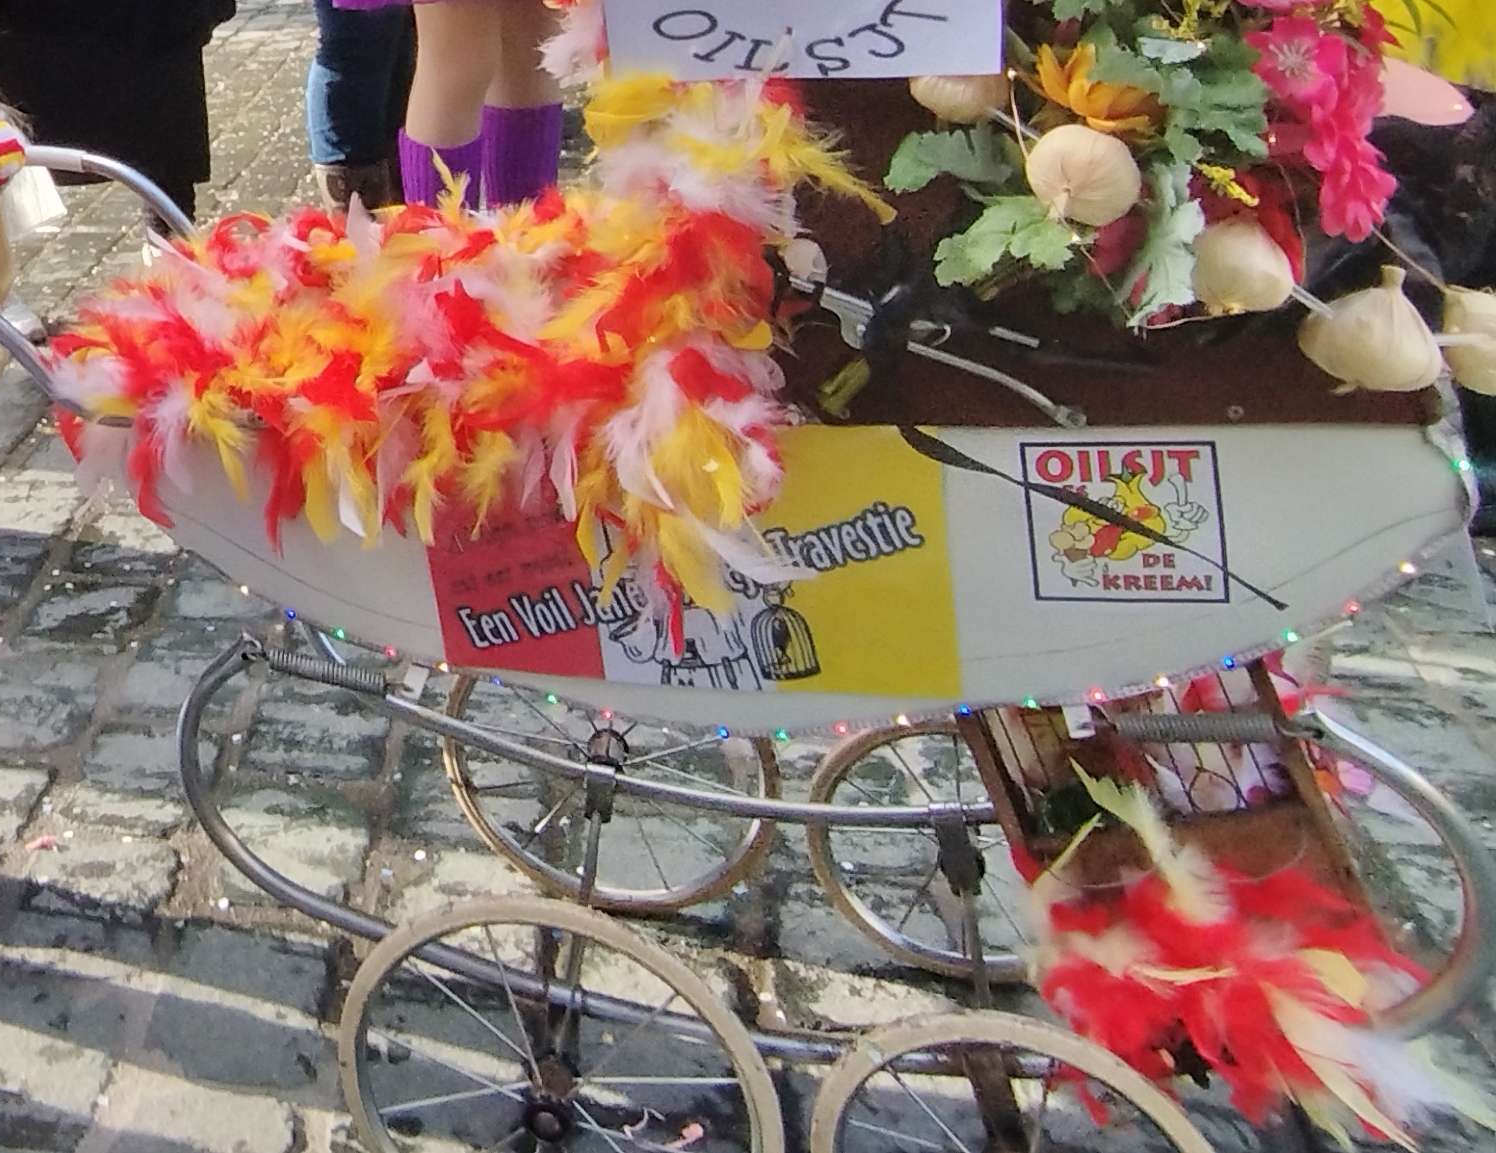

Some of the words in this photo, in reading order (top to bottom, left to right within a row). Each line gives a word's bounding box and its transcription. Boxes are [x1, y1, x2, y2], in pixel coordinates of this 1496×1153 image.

[1035, 449, 1201, 487] OILSJT
[1141, 552, 1176, 568] DE
[457, 606, 522, 651] Een
[508, 583, 580, 640] Voil
[761, 500, 925, 573] Travestie
[1101, 574, 1213, 592] KREEM!
